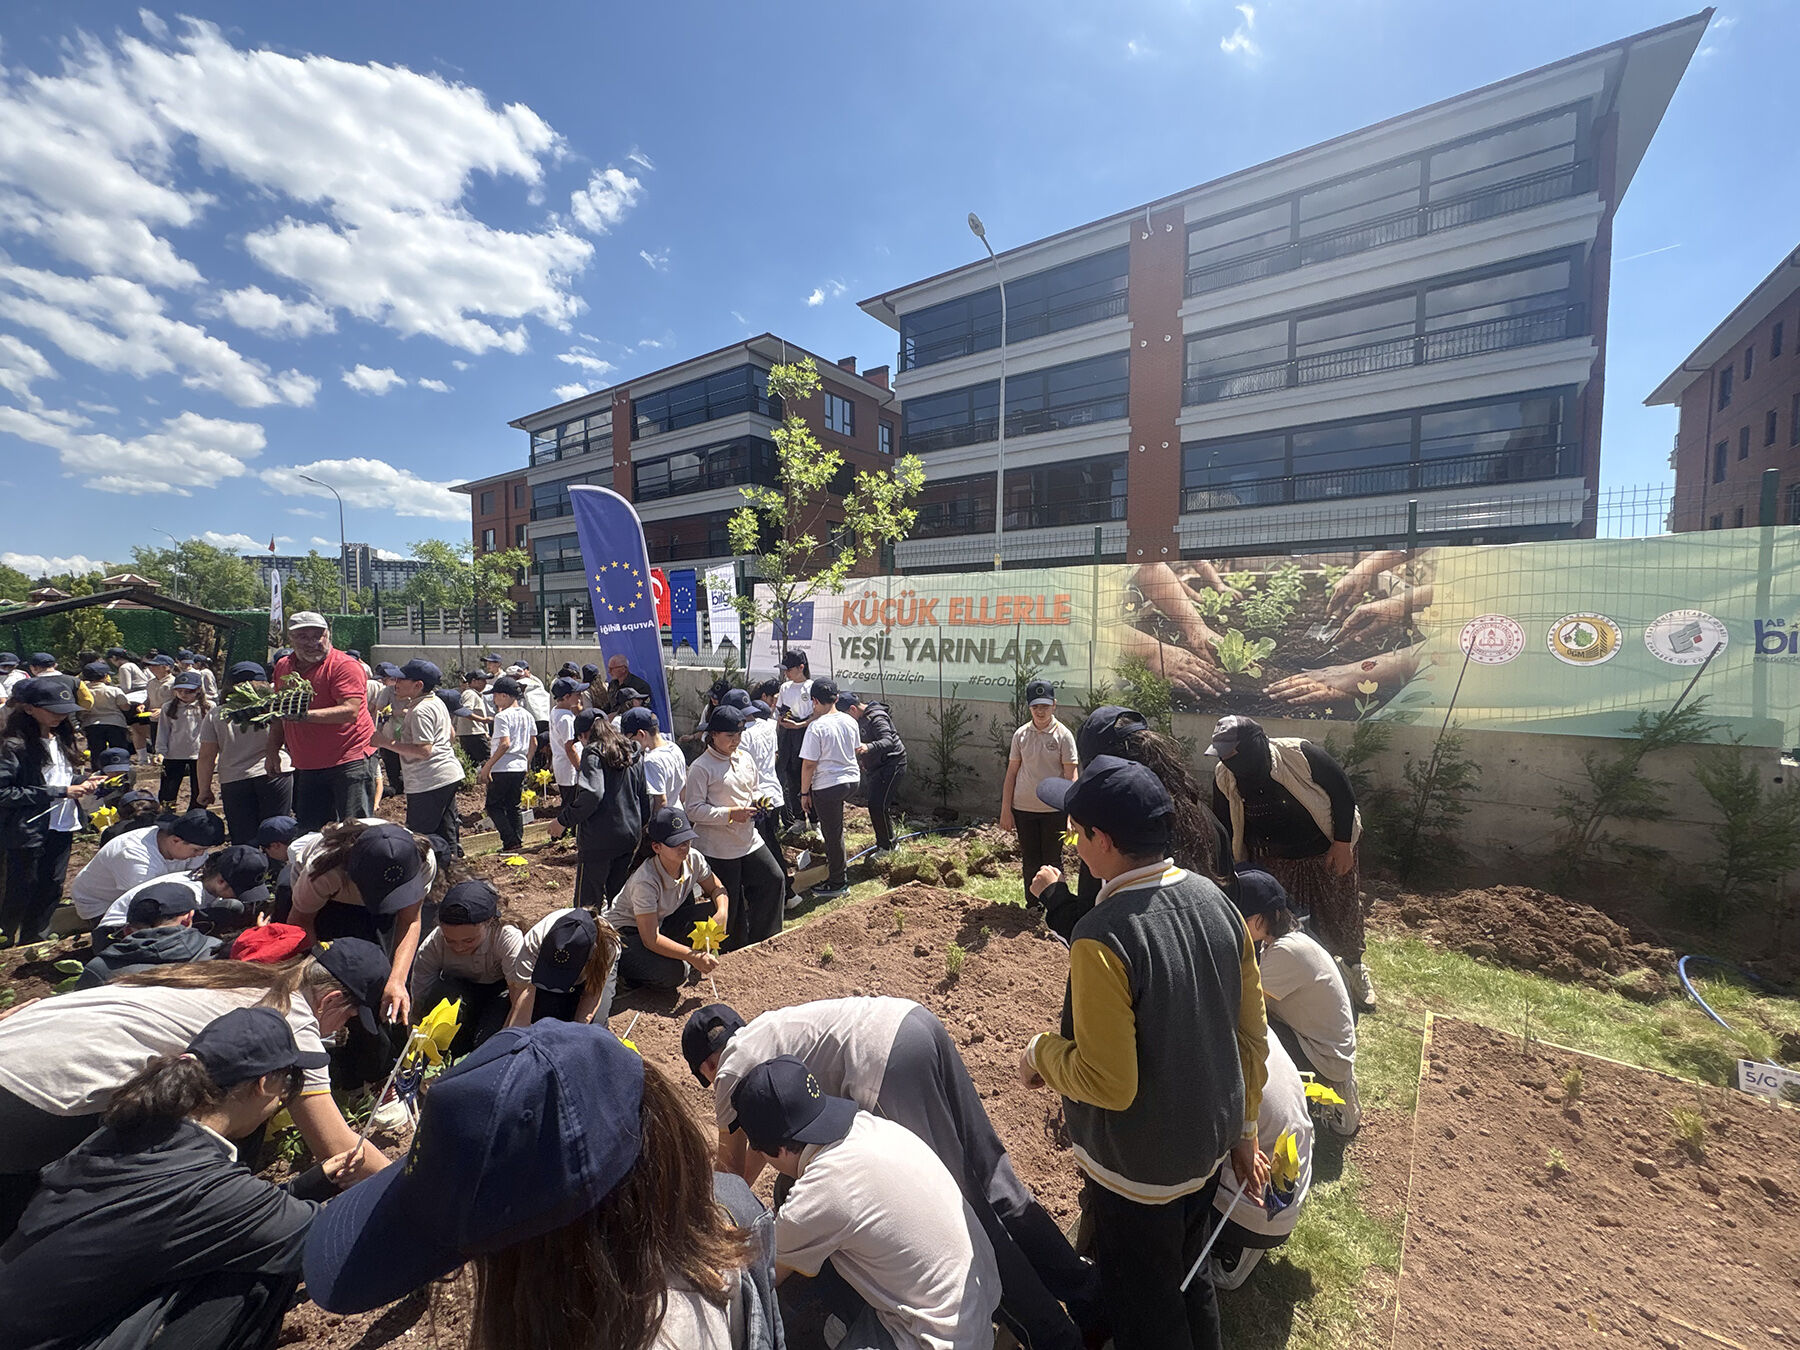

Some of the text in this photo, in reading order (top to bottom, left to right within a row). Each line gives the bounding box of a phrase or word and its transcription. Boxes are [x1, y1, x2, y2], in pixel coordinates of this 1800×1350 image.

[842, 590, 1071, 634] KÜÇÜK ELLERLE
[1765, 618, 1786, 627] AB
[838, 630, 1069, 666] YEŞİL YARINLARA
